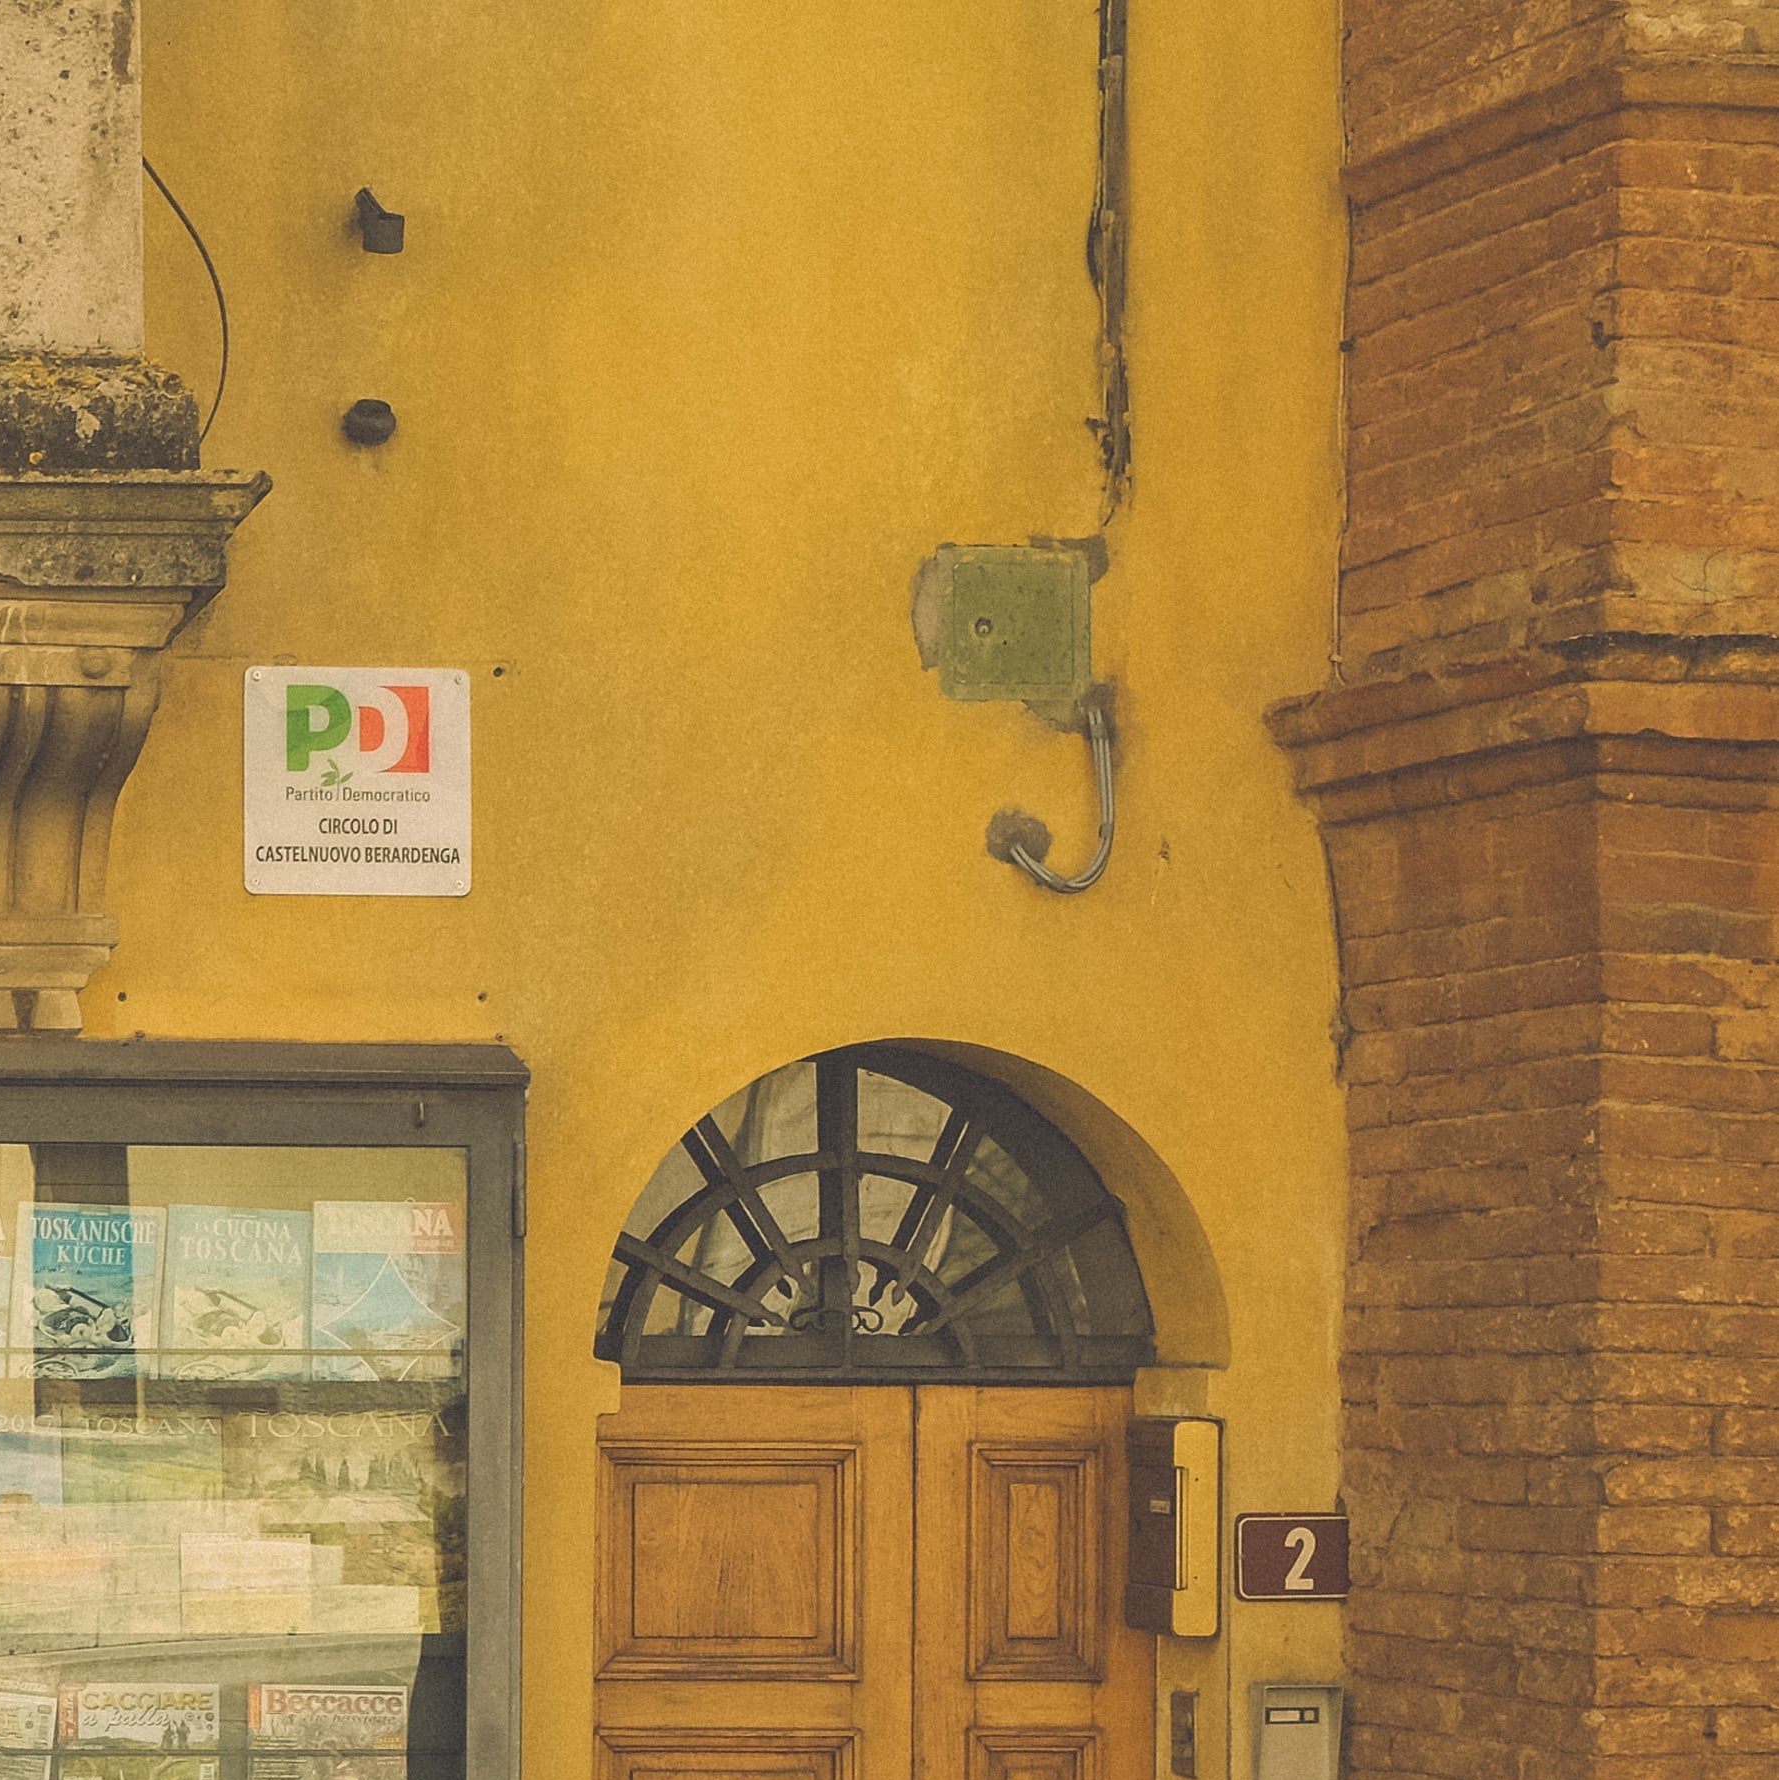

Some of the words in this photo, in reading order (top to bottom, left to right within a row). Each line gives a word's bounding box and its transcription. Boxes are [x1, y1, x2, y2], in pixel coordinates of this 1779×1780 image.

[287, 685, 430, 773] PD
[286, 786, 333, 801] Partito
[342, 787, 430, 803] Democratico
[319, 818, 379, 834] CIRCOLO
[383, 819, 398, 834] DI
[256, 846, 361, 862] CASTELNUOVO
[365, 847, 460, 864] BERARDENGA
[29, 1216, 154, 1245] TOSKANISCHE
[213, 1219, 292, 1239] CUCINA
[57, 1242, 126, 1266] KÜCHE
[179, 1236, 303, 1266] TOSCANA
[78, 1416, 218, 1438] TOSCANA
[238, 1409, 455, 1438] TOSCANA
[1283, 1526, 1317, 1591] 2
[81, 1690, 213, 1712] CACCIARE
[267, 1688, 403, 1716] Beccacce
[105, 1708, 171, 1731] palla
